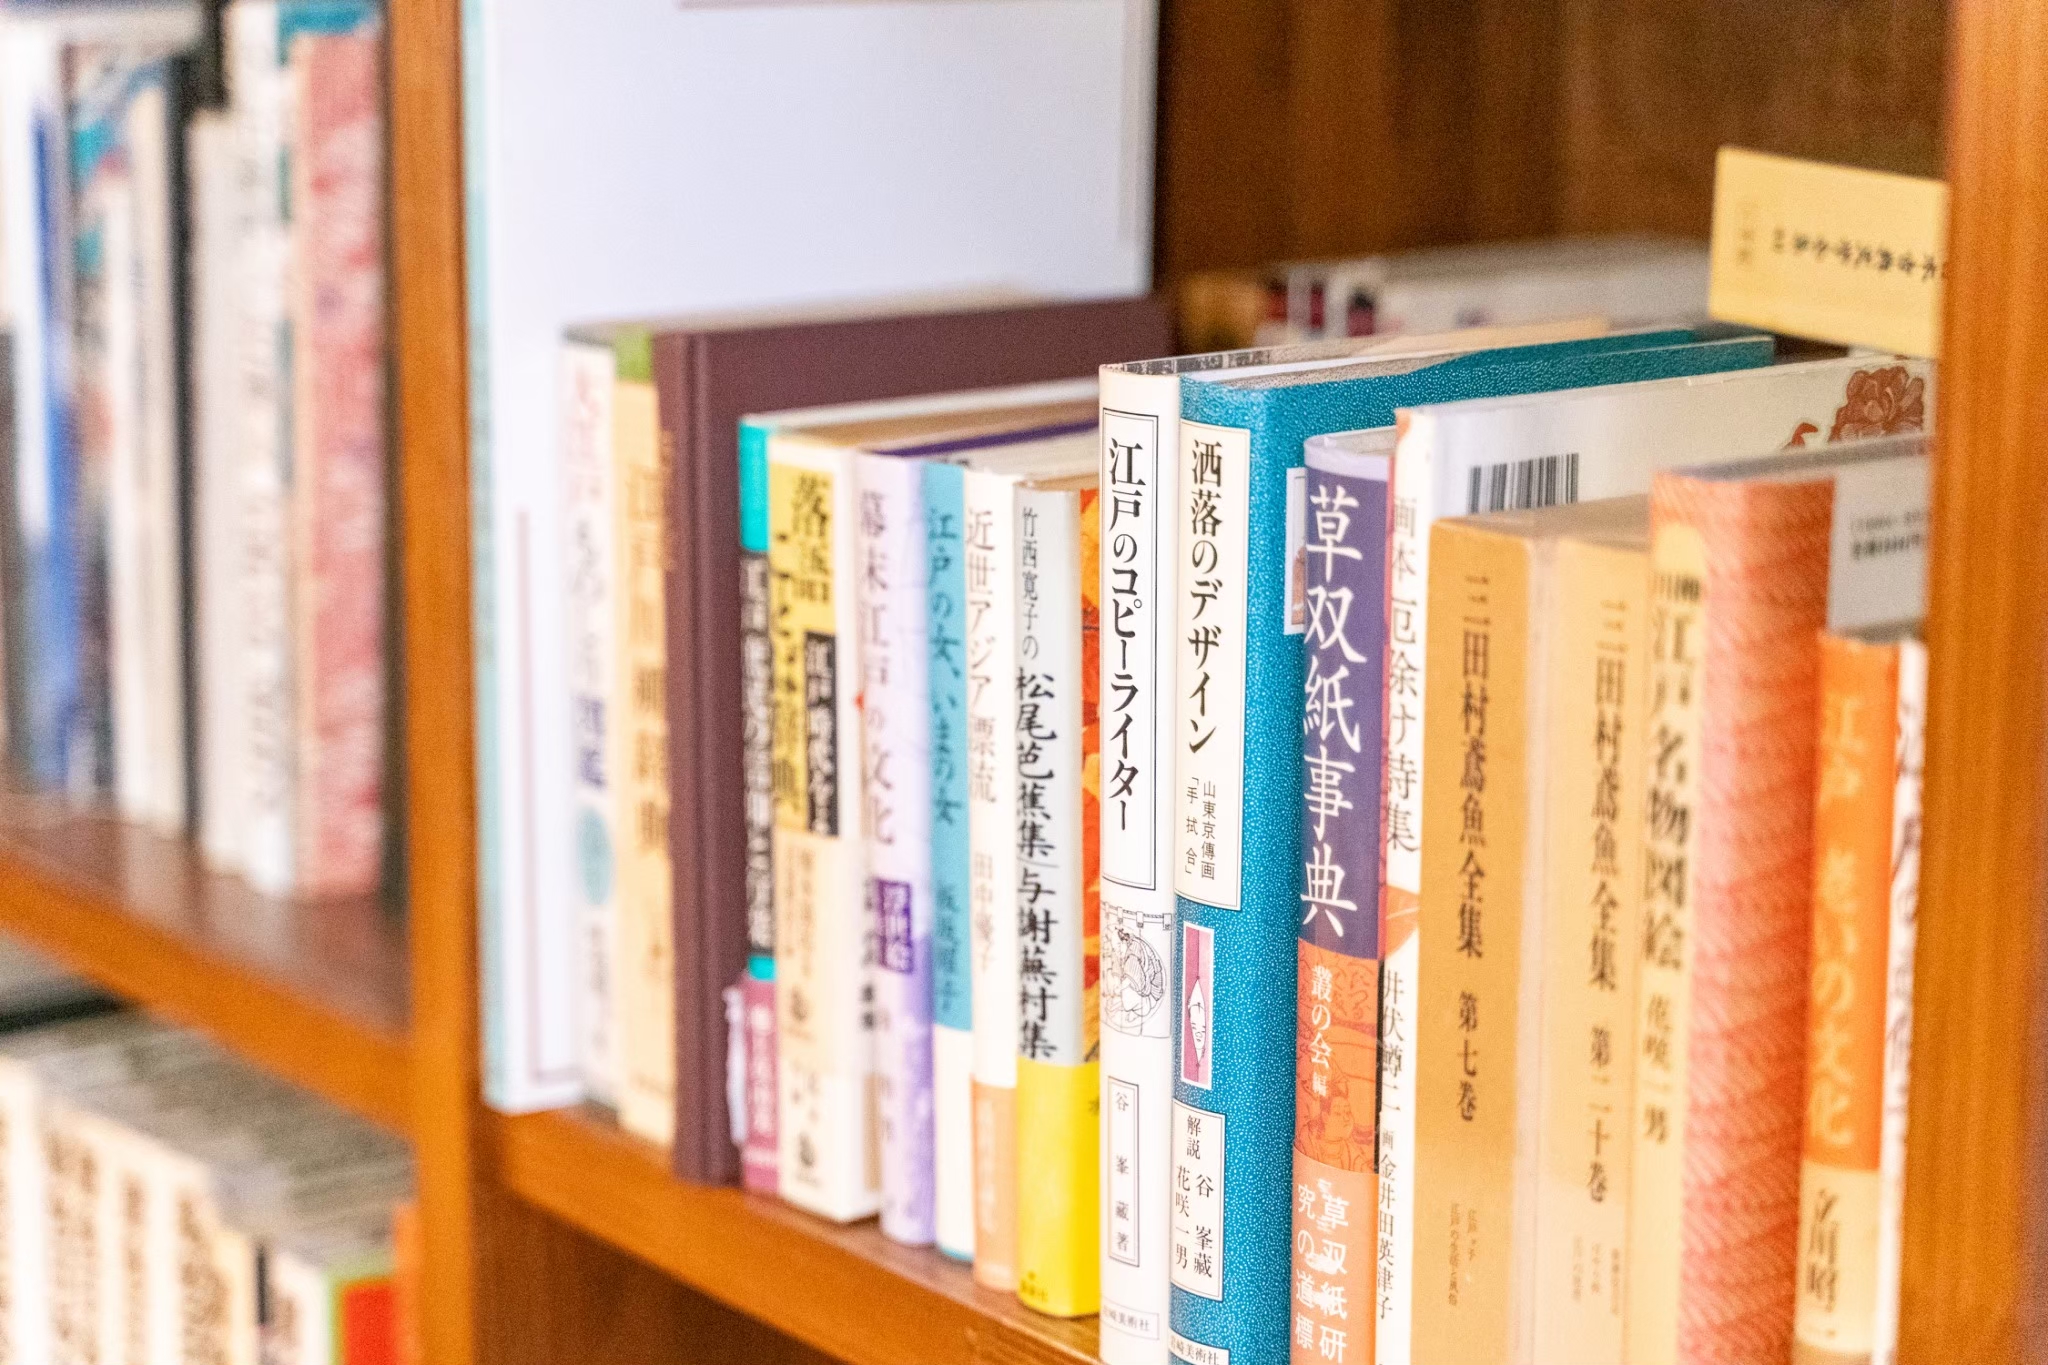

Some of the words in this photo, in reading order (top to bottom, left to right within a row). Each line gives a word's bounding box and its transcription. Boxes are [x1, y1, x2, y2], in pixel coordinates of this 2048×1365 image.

[1022, 506, 1039, 661] 竹西寛子の
[1109, 437, 1146, 831] 江戸のコピーライター
[1188, 439, 1222, 754] 洒落のデザイン
[1300, 484, 1366, 937] 草双紙事典
[1457, 575, 1491, 959] 三田村鳶魚全集
[1201, 780, 1216, 881] 山東京傳画
[1590, 601, 1629, 990] 三田村鳶魚全集
[1383, 969, 1405, 1113] 井伏鱒二
[1457, 991, 1479, 1122] 第七巻
[1586, 1026, 1612, 1202] 第二十巻
[1175, 1164, 1191, 1270] 花咲一男
[1187, 1115, 1202, 1160] 解説
